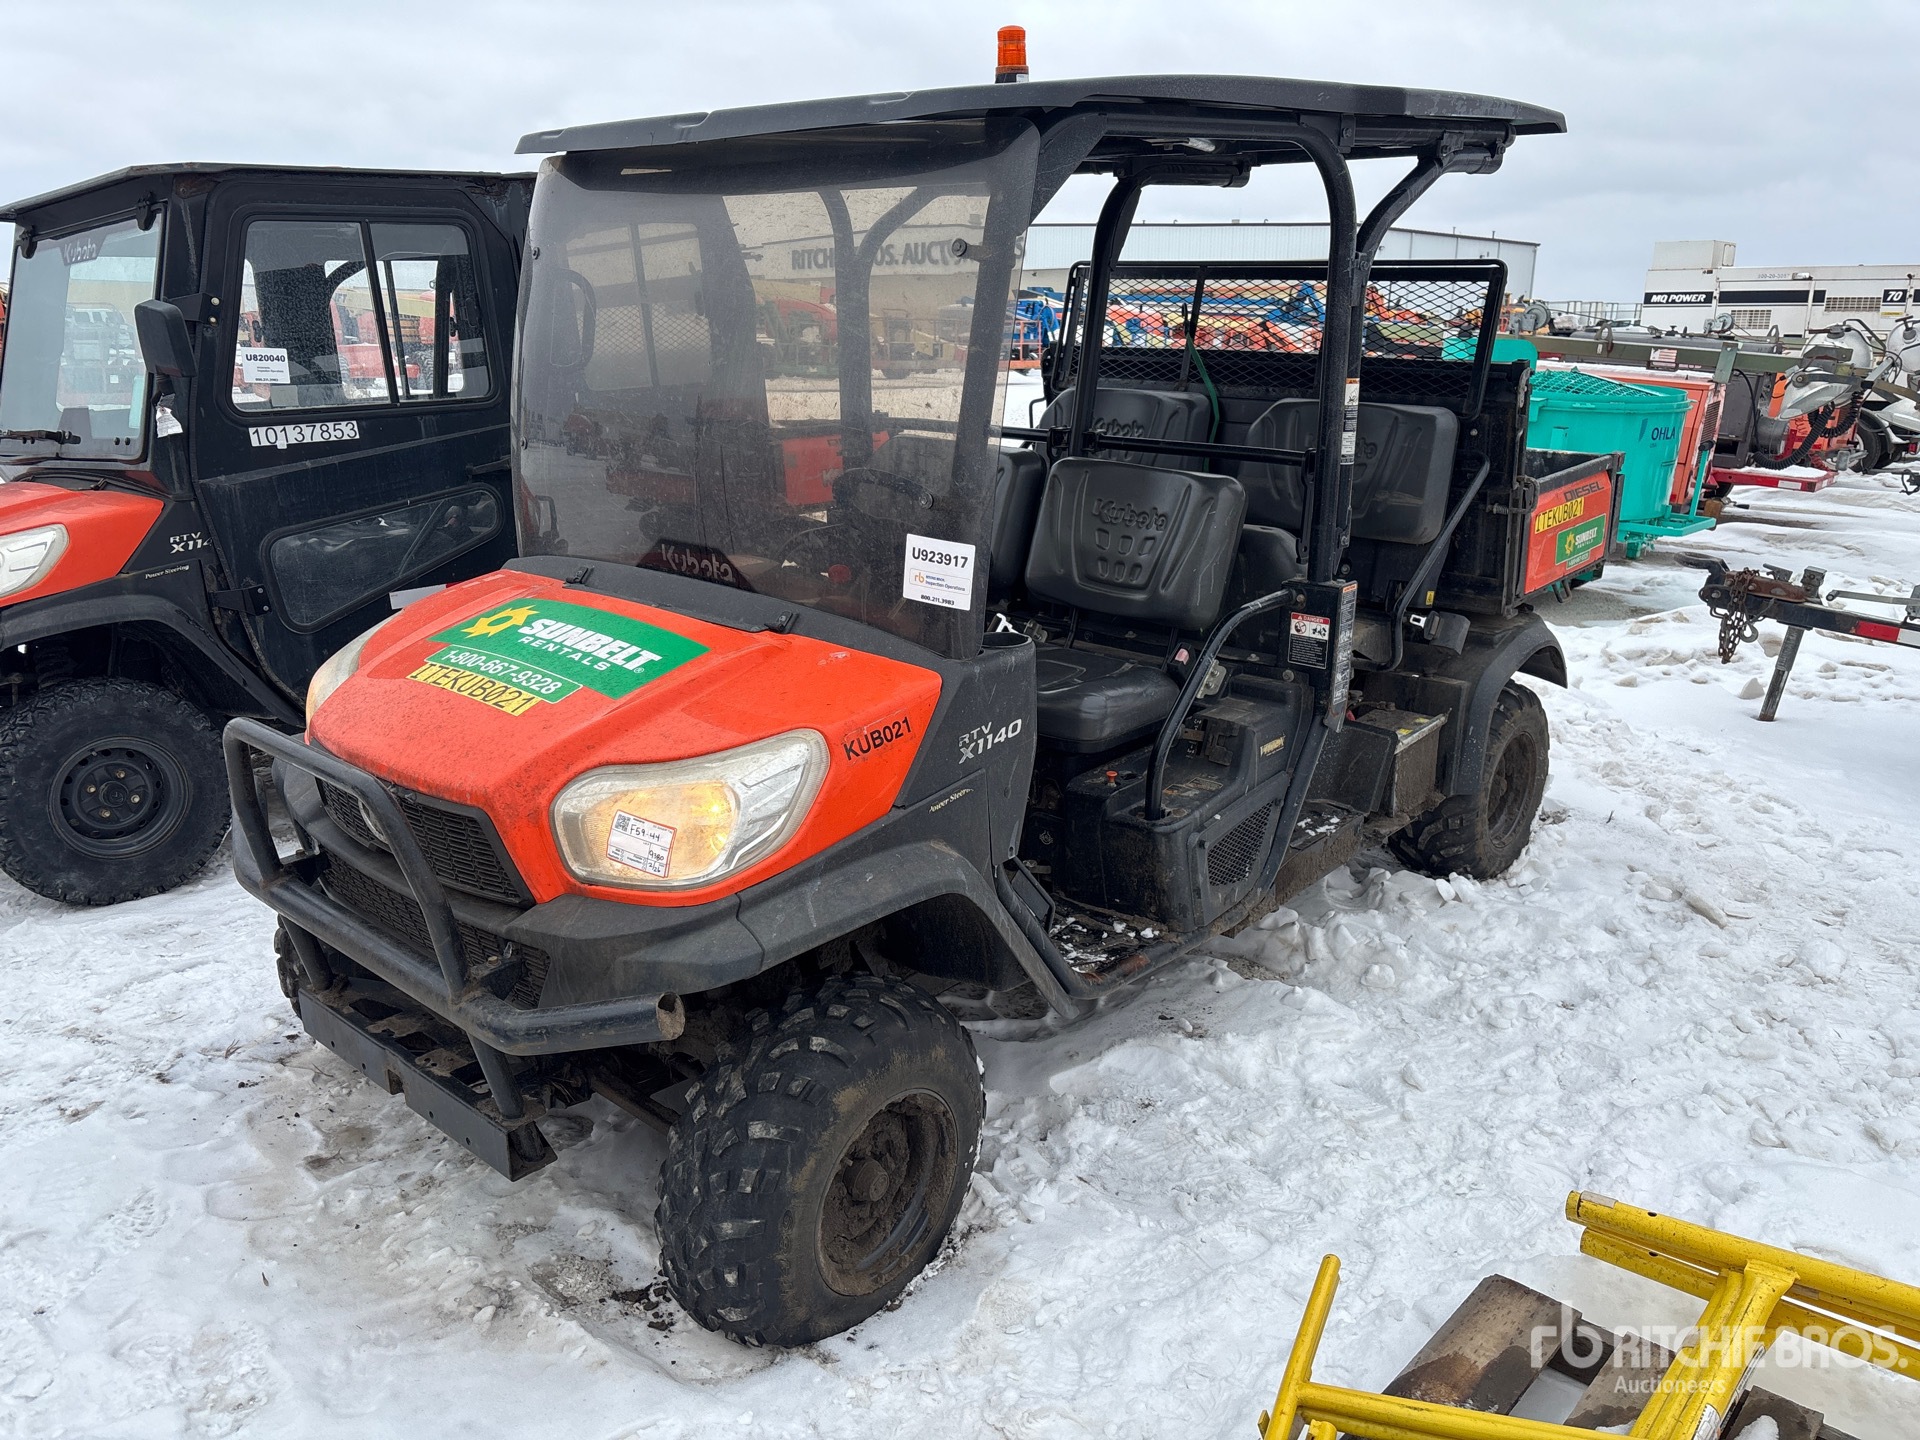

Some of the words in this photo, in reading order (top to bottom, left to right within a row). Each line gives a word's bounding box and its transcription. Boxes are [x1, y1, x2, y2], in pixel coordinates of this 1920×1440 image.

[1651, 294, 1668, 303] MQ
[1669, 293, 1706, 302] POWER
[1886, 291, 1903, 301] 70
[245, 353, 286, 363] U820040
[252, 421, 358, 445] 10137853
[1651, 426, 1676, 441] OHLA
[1564, 481, 1605, 502] DIESEL
[1092, 498, 1167, 531] Kubota
[169, 532, 201, 543] RTV
[661, 543, 736, 582] Kubota
[912, 547, 968, 568] U923917
[145, 570, 164, 579] Power
[164, 565, 190, 575] Steering
[914, 572, 925, 583] rb
[517, 618, 663, 671] SUNBELT
[518, 636, 611, 671] RENTALS
[440, 649, 563, 695] 1-800-667-9328
[843, 716, 912, 760] KUB021
[958, 721, 992, 747] RTV
[958, 718, 1022, 764] X1140
